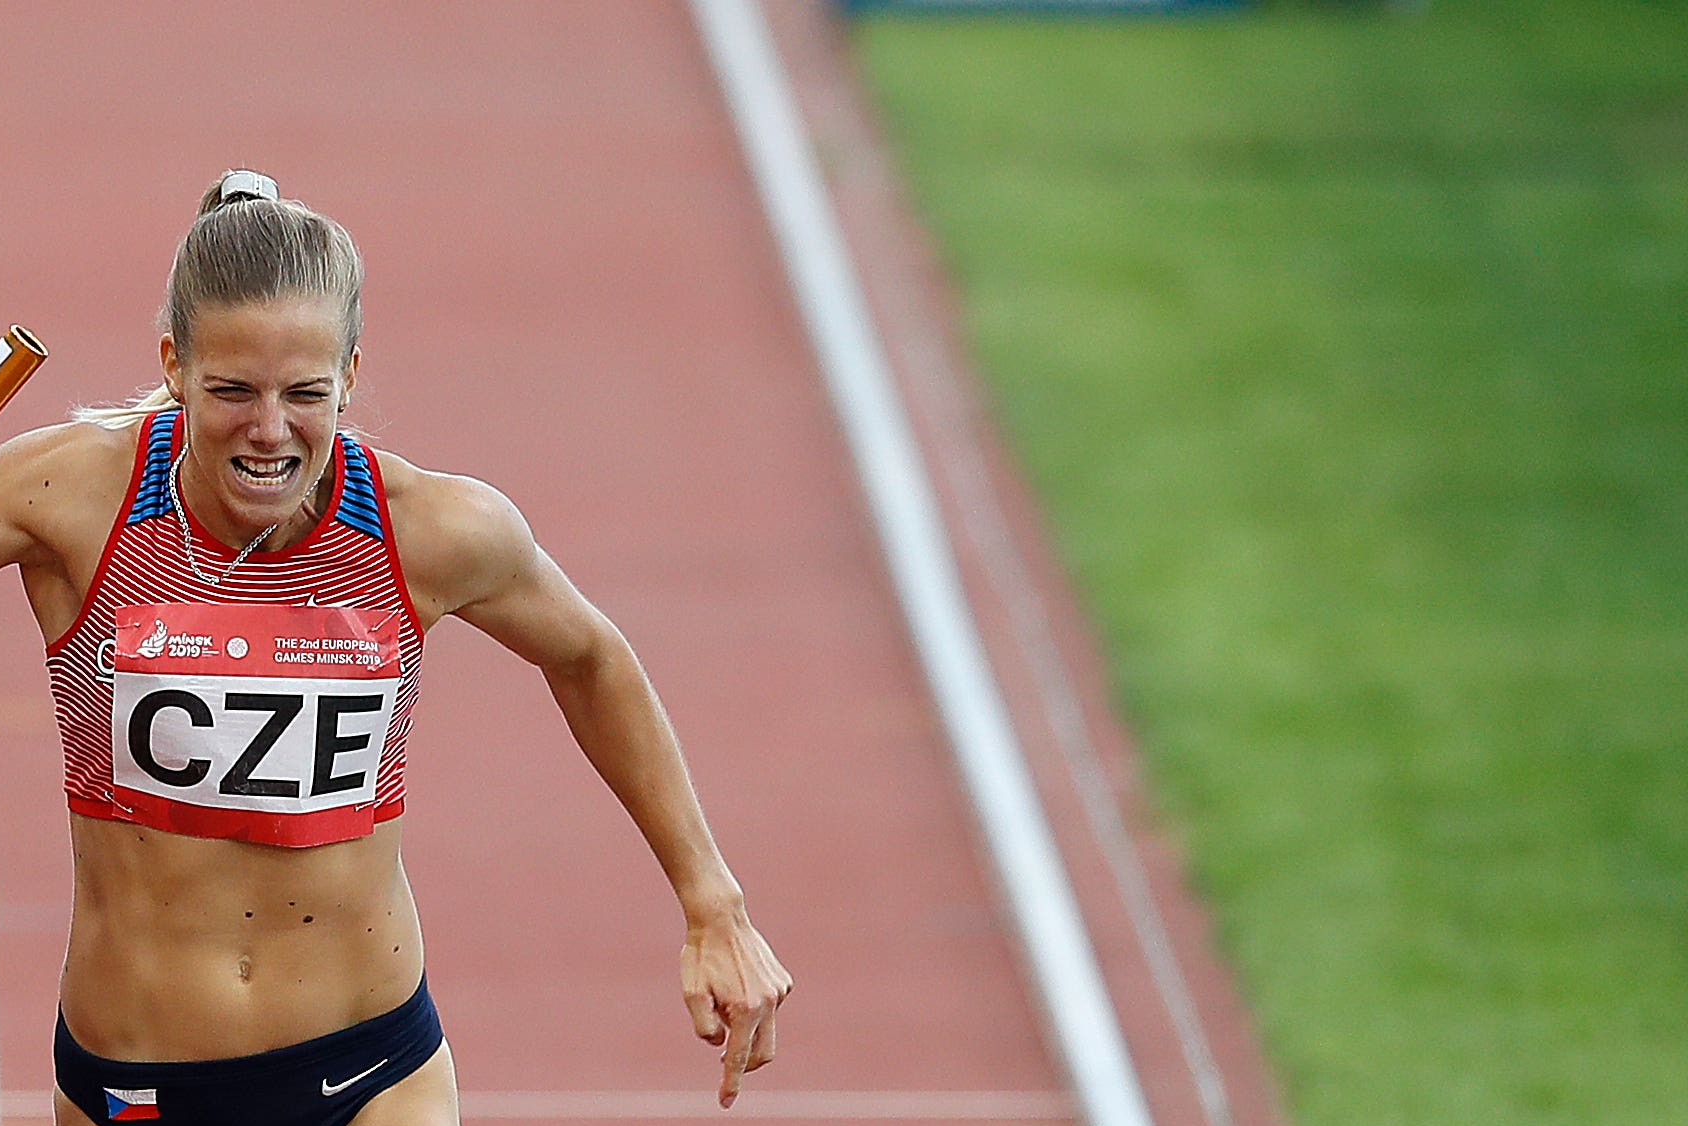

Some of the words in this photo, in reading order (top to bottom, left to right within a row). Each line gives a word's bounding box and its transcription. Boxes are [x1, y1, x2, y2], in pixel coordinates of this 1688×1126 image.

[168, 645, 201, 658] 2019
[274, 637, 297, 649] THE
[299, 638, 320, 649] 2nd
[322, 639, 379, 652] EUROPEAN
[274, 652, 315, 663] GAMES
[316, 653, 354, 664] MINSK
[355, 654, 381, 665] 2019
[128, 689, 385, 799] CZE
